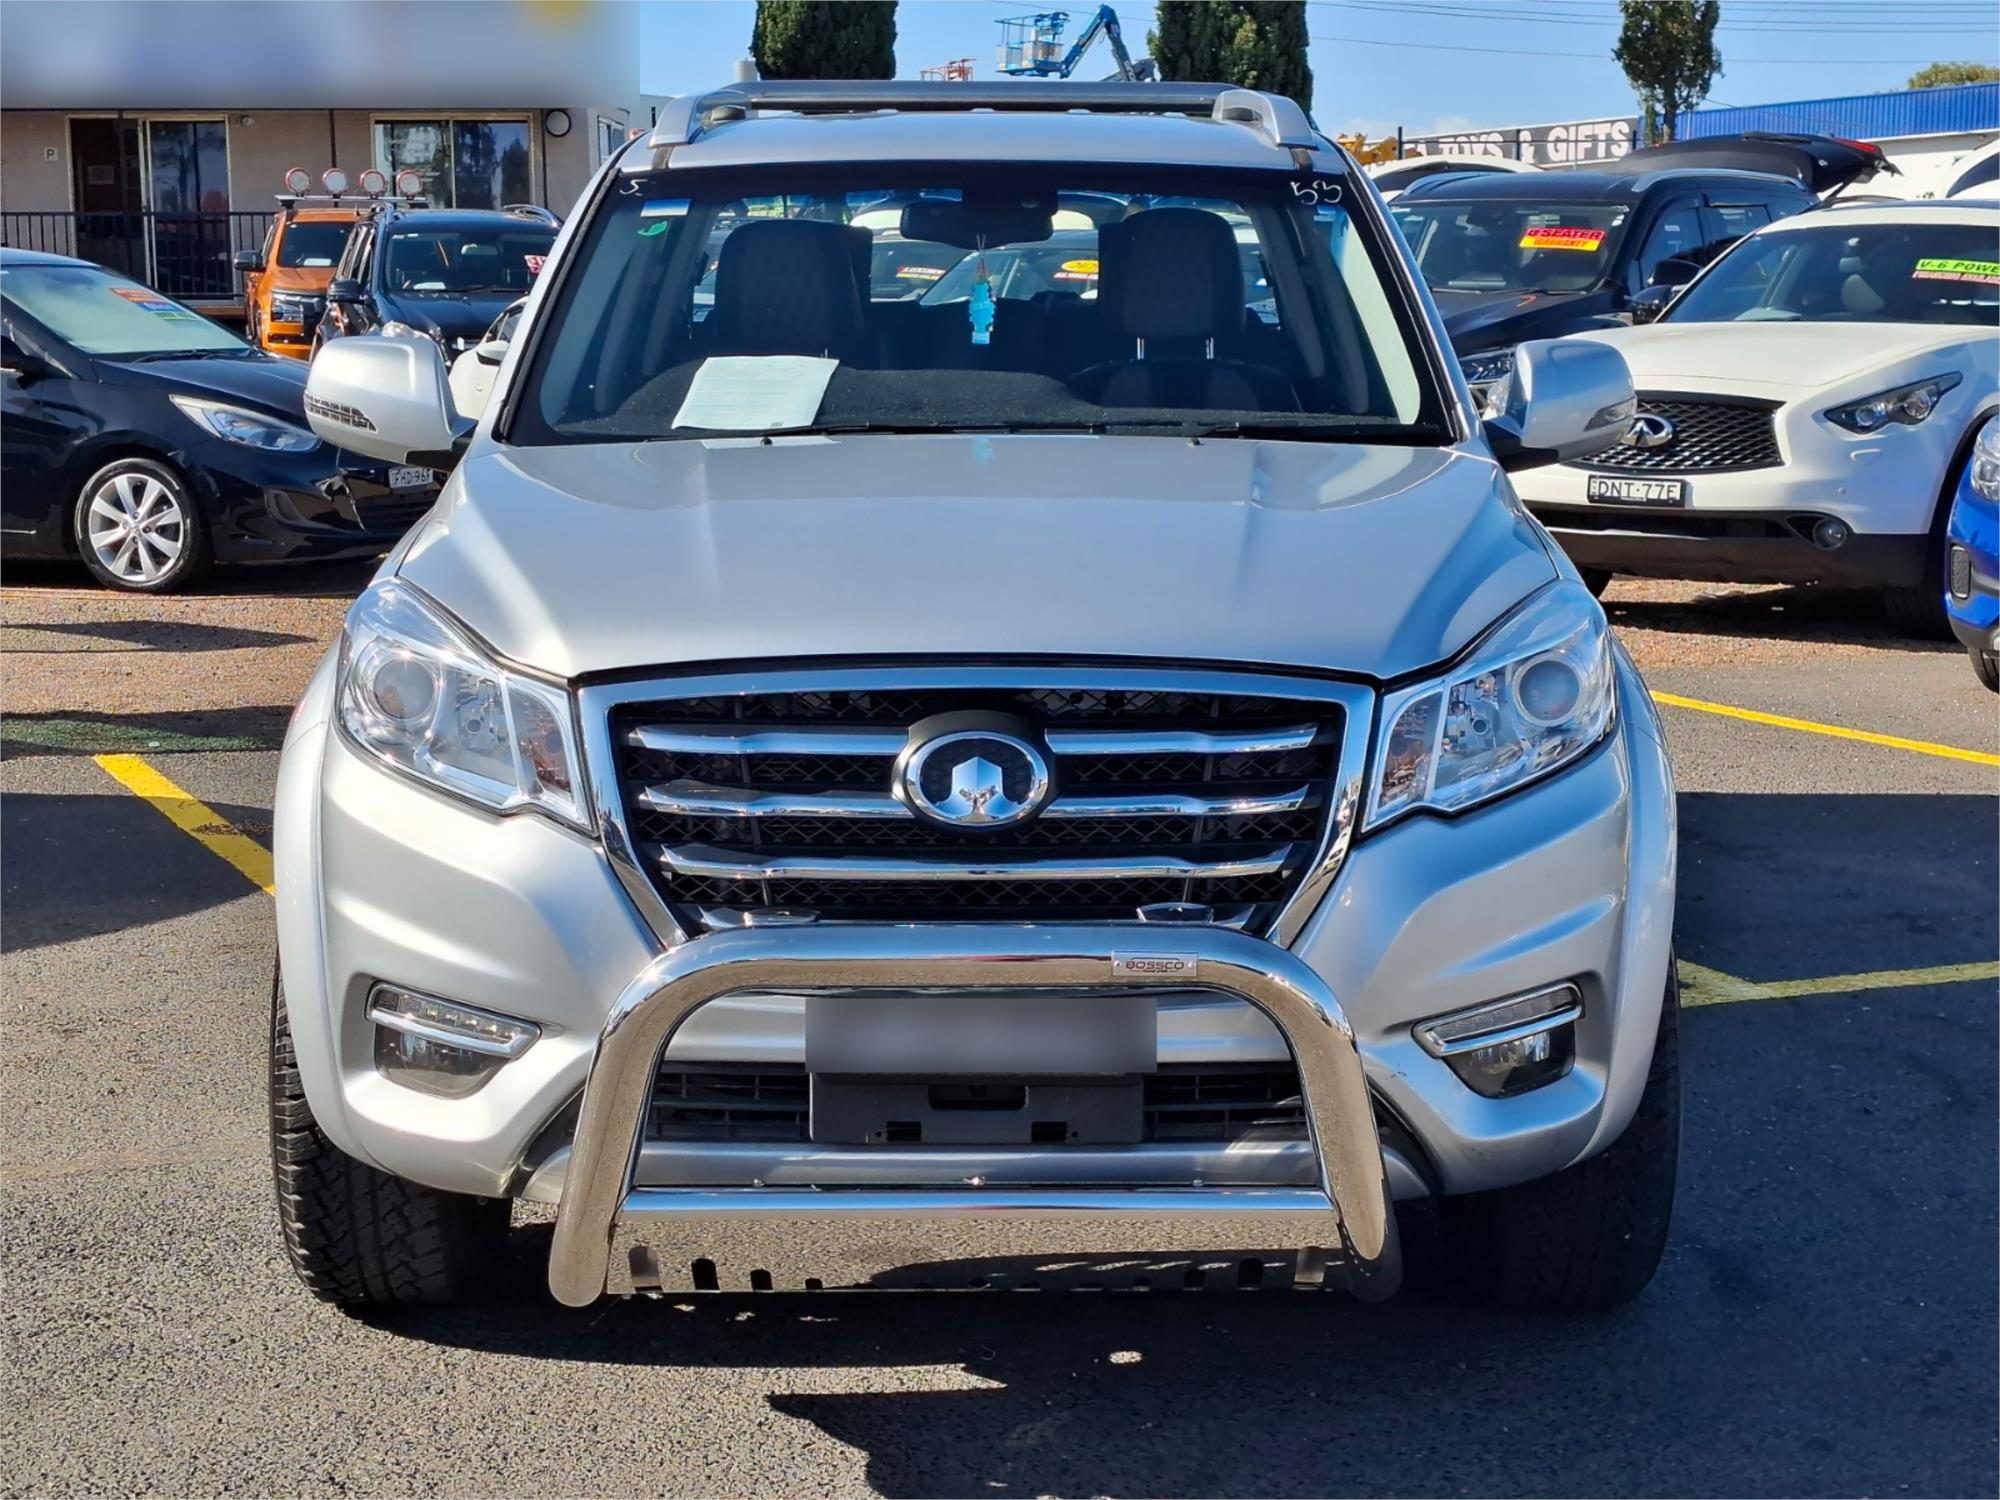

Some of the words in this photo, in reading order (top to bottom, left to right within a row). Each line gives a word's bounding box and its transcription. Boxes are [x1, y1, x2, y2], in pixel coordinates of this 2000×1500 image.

[1547, 121, 1630, 162] GIFTS
[47, 148, 55, 159] P
[1540, 229, 1603, 240] SEATER
[1125, 960, 1184, 970] BOSSCO
